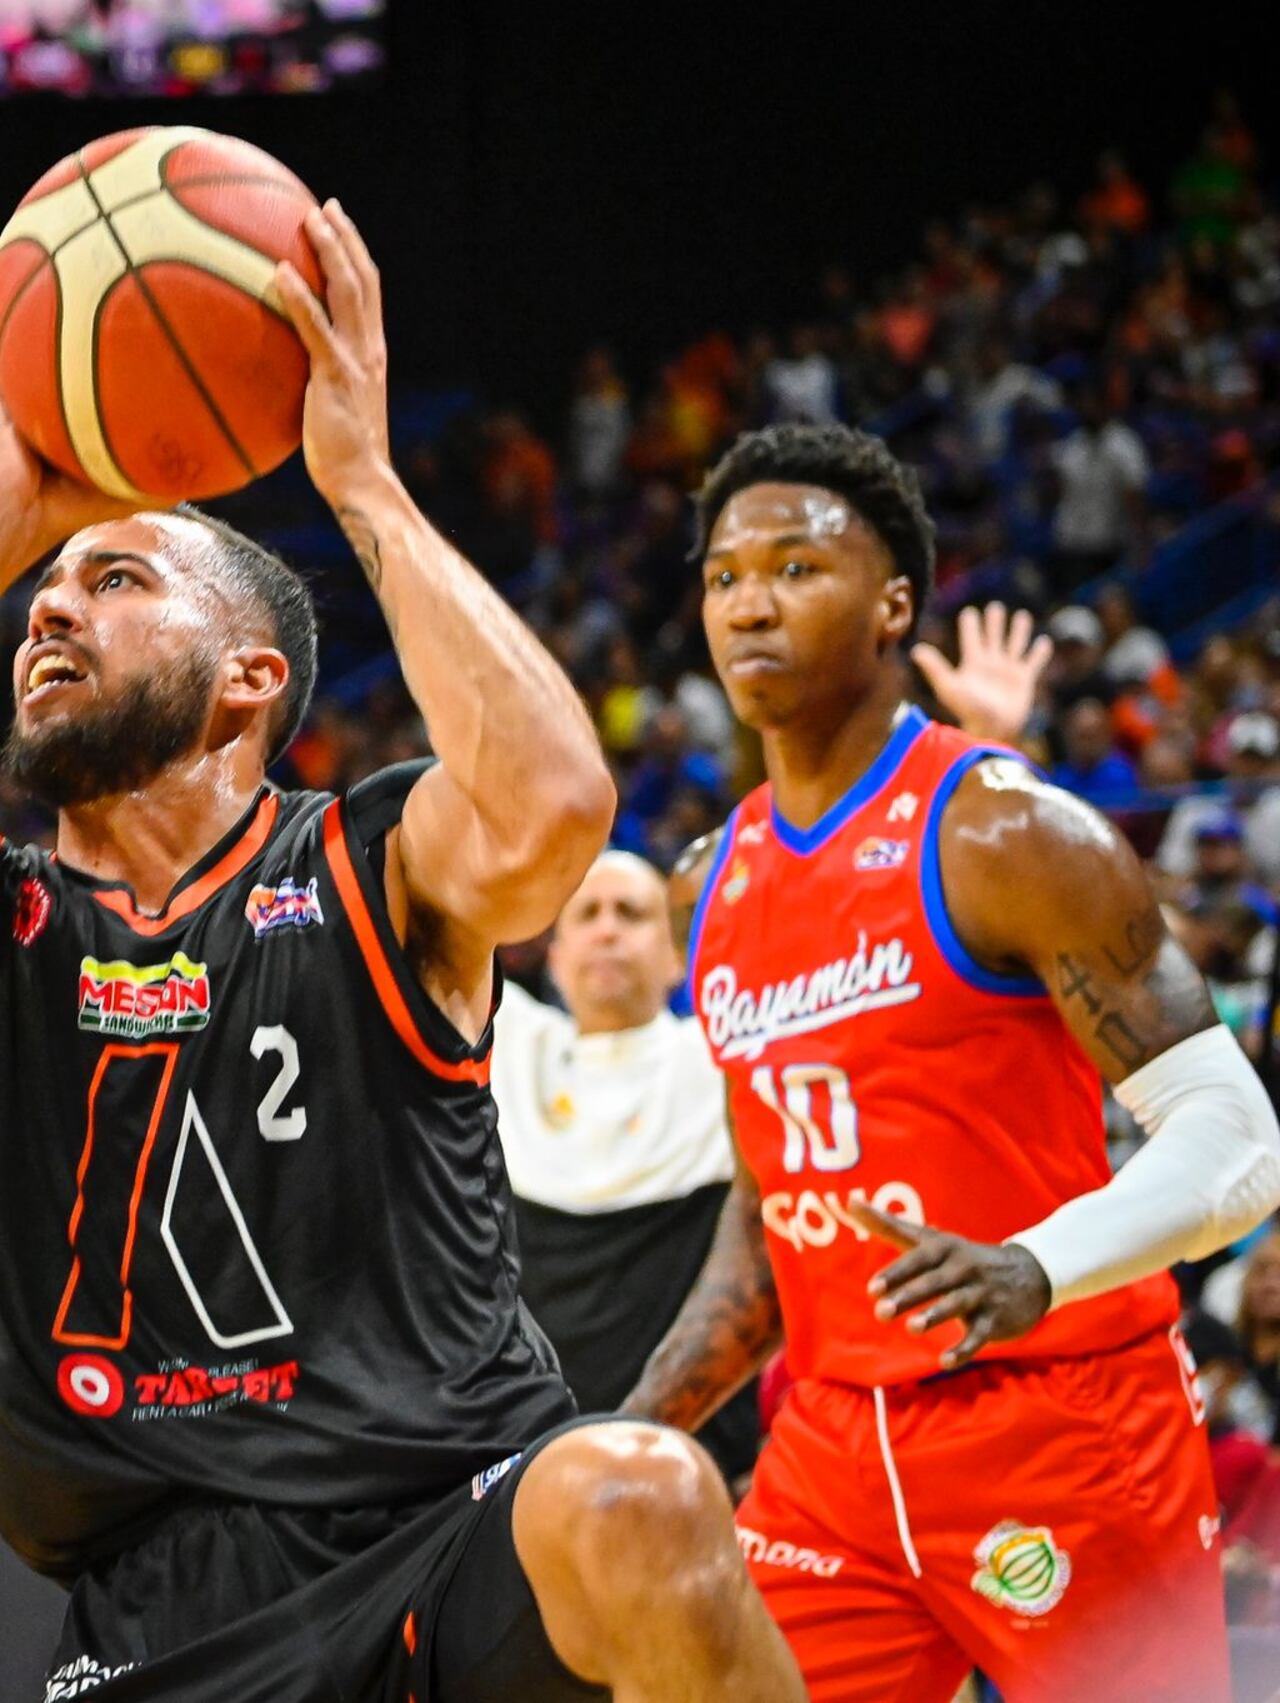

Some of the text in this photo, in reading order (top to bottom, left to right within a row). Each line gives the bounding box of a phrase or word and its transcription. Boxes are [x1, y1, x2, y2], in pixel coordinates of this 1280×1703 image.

[702, 929, 913, 1061] Bayamón
[250, 1024, 307, 1142] 2
[750, 1064, 861, 1174] 10
